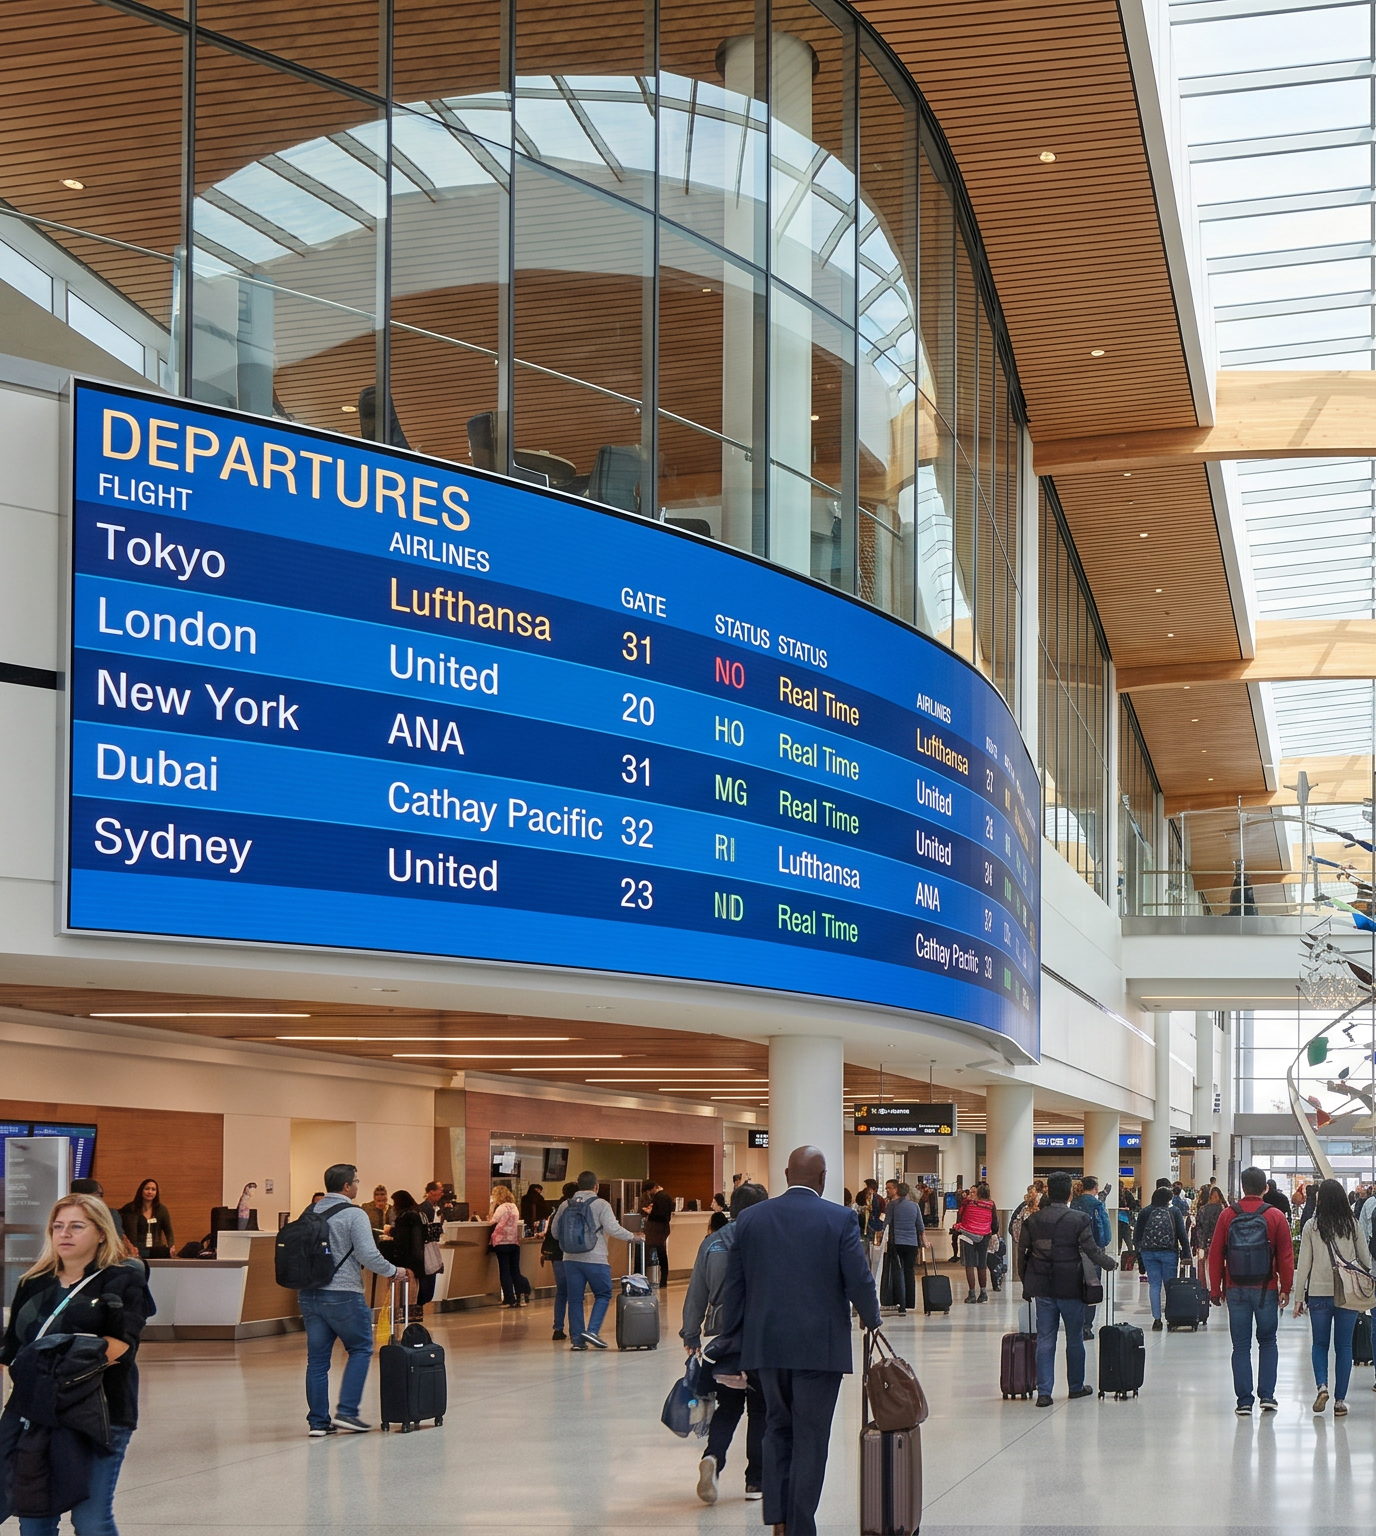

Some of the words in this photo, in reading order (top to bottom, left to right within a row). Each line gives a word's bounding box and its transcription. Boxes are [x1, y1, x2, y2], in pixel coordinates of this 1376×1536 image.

[99, 470, 195, 511] FLIGHT
[103, 408, 472, 532] DEPARTURES
[96, 521, 226, 581] Tokyo
[389, 528, 490, 573] AIRLINES
[391, 577, 552, 642] Lufthansa
[621, 587, 667, 618] GATE
[99, 596, 257, 655] London
[622, 631, 651, 665] 31
[714, 613, 771, 649] STATUS
[778, 635, 828, 669] STATUS
[390, 643, 499, 696] United
[715, 656, 745, 689] NO
[97, 668, 192, 716] New
[204, 683, 300, 731] York
[622, 692, 655, 726] 20
[779, 675, 818, 712] Real
[822, 690, 860, 727] Time
[387, 712, 465, 756] ANA
[779, 732, 818, 768] Real
[822, 746, 860, 781] Time
[916, 727, 969, 776] Lufthansa
[97, 742, 218, 792] Dubai
[621, 754, 650, 787] 31
[388, 781, 498, 832] Cathay
[508, 797, 603, 841] Pacific
[715, 774, 747, 807] MG
[779, 789, 817, 824] Real
[822, 801, 859, 835] Time
[916, 778, 952, 817] United
[94, 817, 253, 874] Sydney
[621, 815, 654, 849] 32
[916, 829, 952, 866] United
[388, 847, 498, 892] United
[778, 845, 861, 890] Lufthansa
[620, 877, 653, 910] 23
[915, 881, 941, 912] ANA
[778, 903, 816, 935] Real
[821, 912, 858, 943] Time
[915, 932, 951, 970] Cathay
